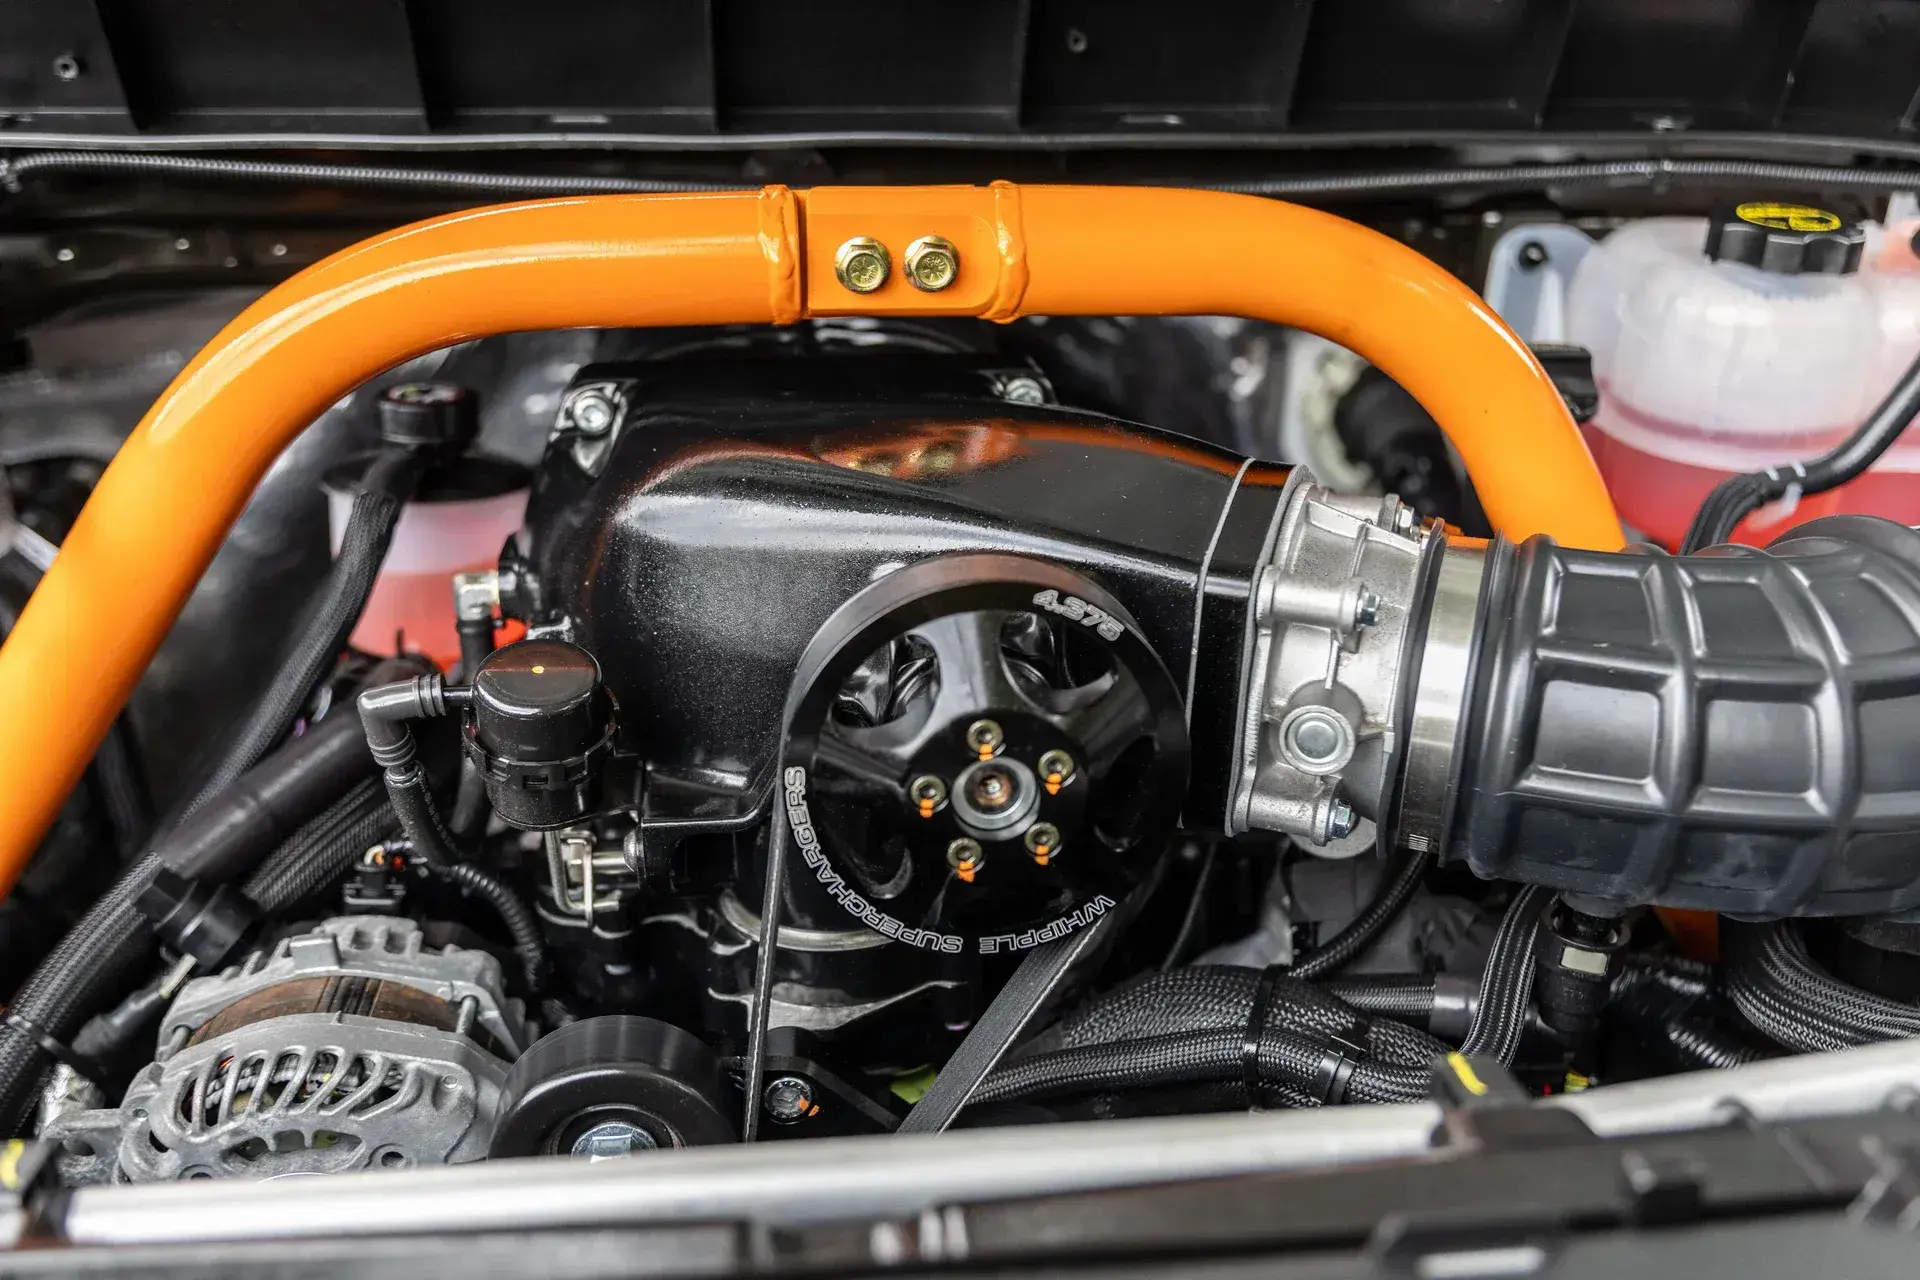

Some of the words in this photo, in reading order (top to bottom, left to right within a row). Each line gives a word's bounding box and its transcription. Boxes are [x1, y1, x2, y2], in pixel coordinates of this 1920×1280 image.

[1032, 589, 1125, 641] 4.375
[784, 765, 964, 953] SUPERCHARGERS
[979, 894, 1116, 954] WHIPPLE
